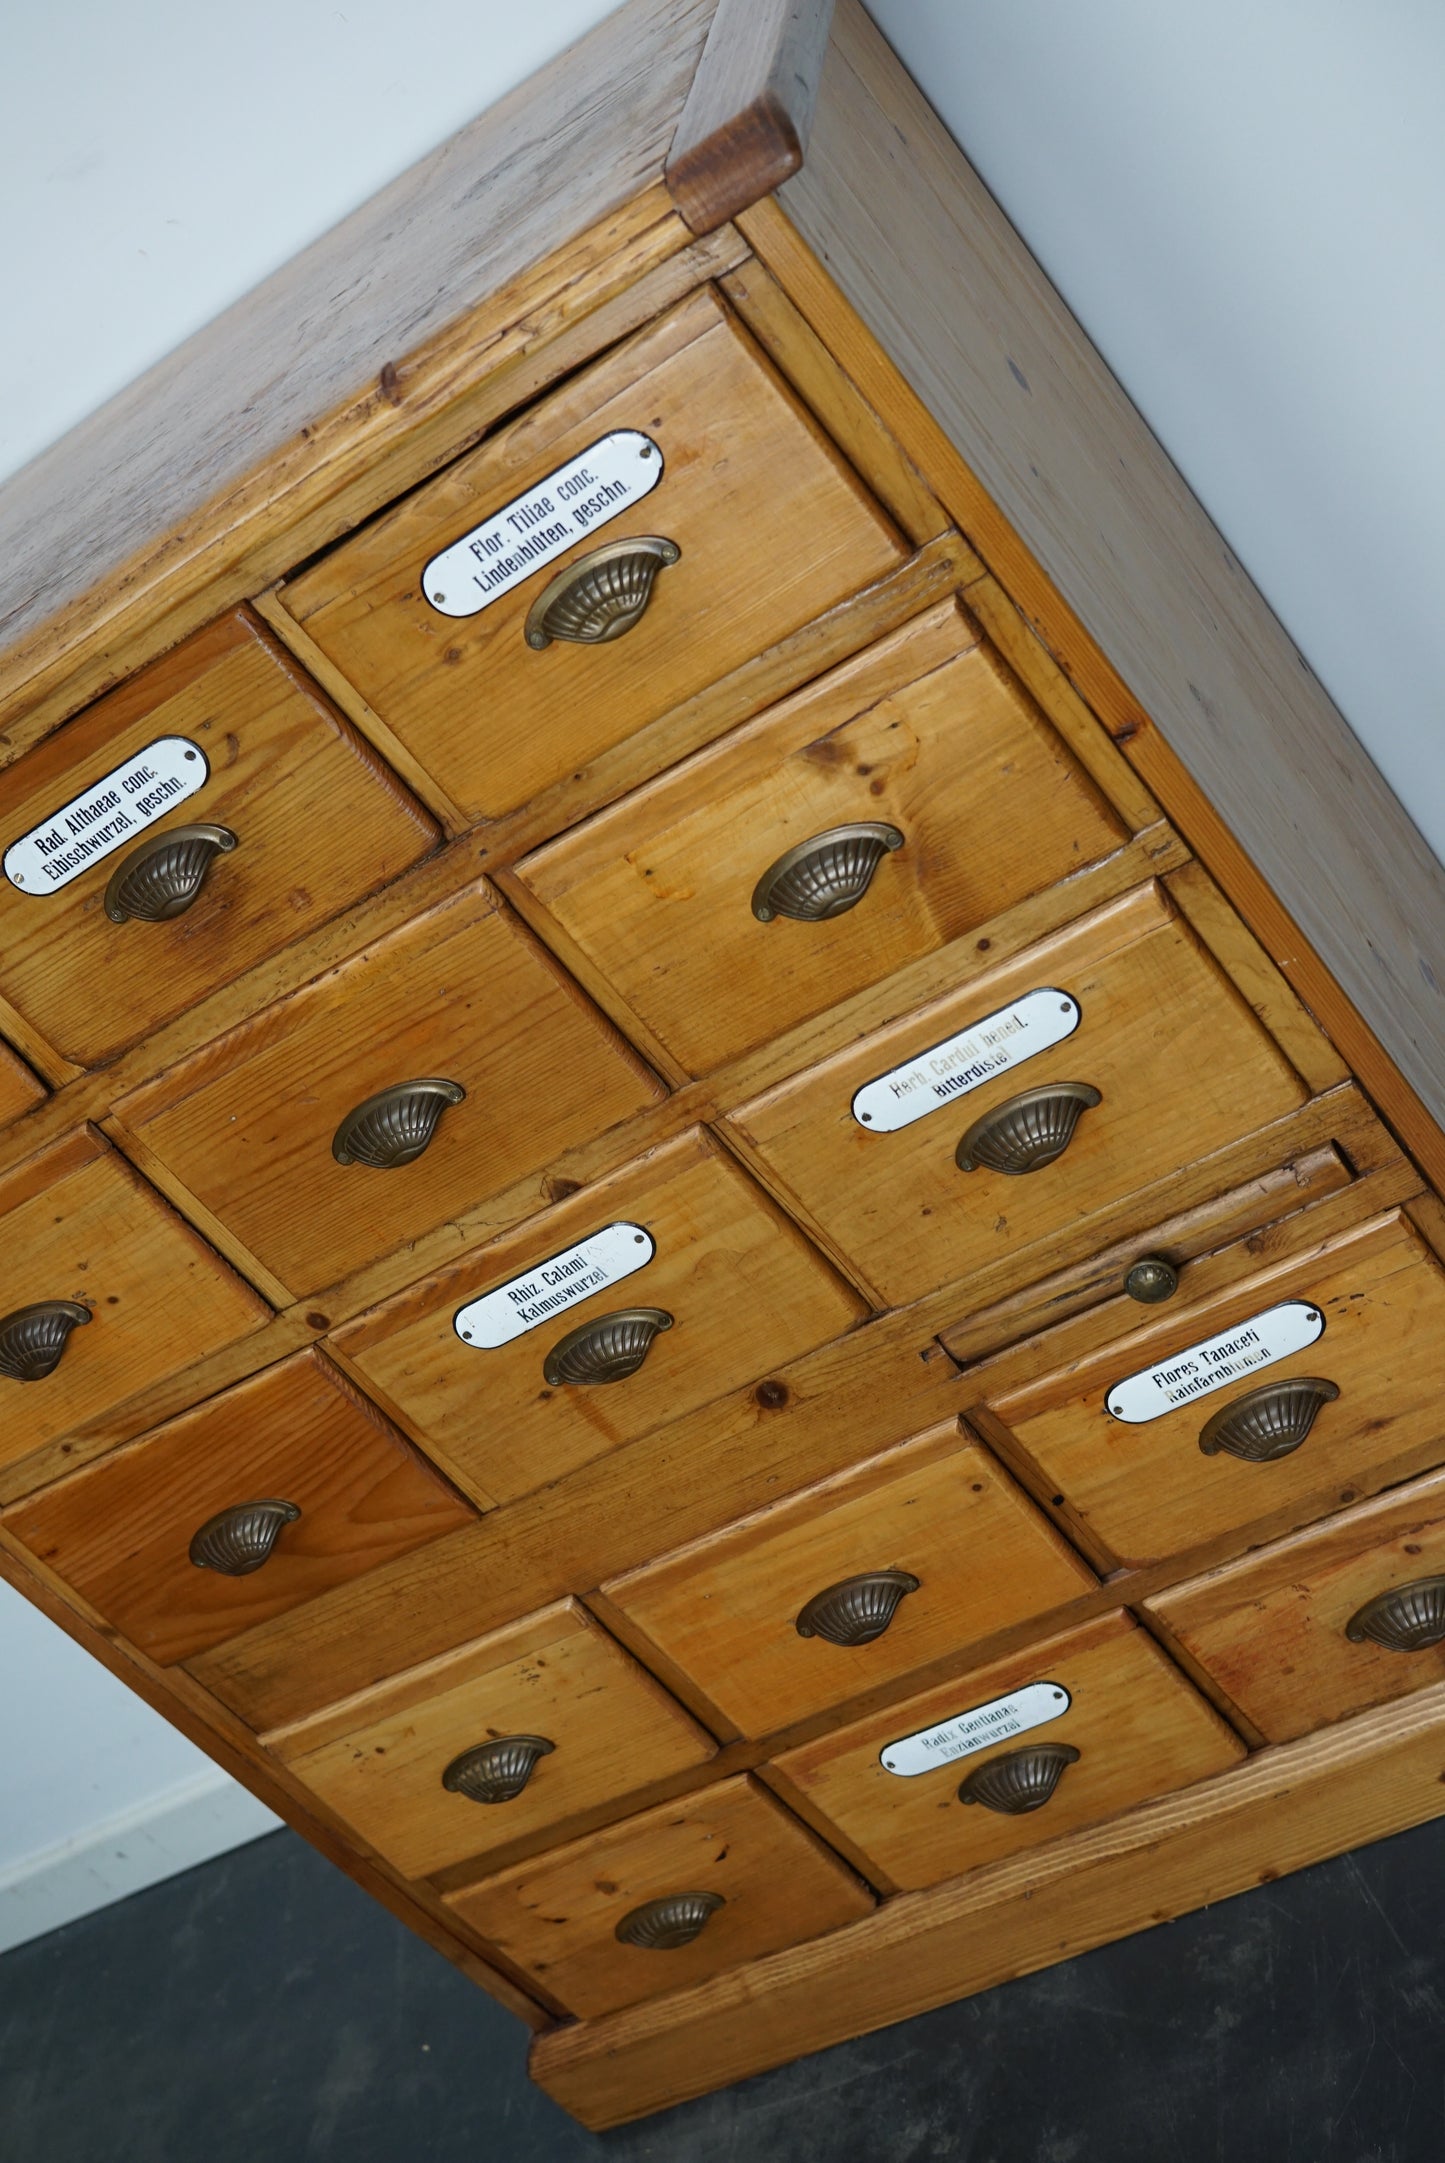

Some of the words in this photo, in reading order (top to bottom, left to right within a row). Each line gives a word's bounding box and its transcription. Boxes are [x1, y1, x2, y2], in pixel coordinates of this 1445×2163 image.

[468, 531, 511, 563] Flor.
[507, 496, 555, 535] Tiliae
[556, 468, 599, 501] conc.
[572, 478, 632, 527] geschn.
[34, 828, 68, 856] Rad.
[64, 790, 121, 836] Althaeae
[121, 766, 158, 794] conc.
[41, 811, 137, 881] Eibischwurzel,
[136, 777, 187, 817] geschn.
[889, 1072, 930, 1099] Herb.
[929, 1040, 980, 1076] Cardui
[931, 1047, 1012, 1098] Bitterdistel
[507, 1281, 544, 1305] Rhiz.
[541, 1254, 588, 1286] Calami
[517, 1267, 608, 1323] Kalmuswurzel
[1152, 1361, 1198, 1388] Flores
[1199, 1329, 1259, 1365] Tanaceti
[921, 1729, 957, 1750] Radix
